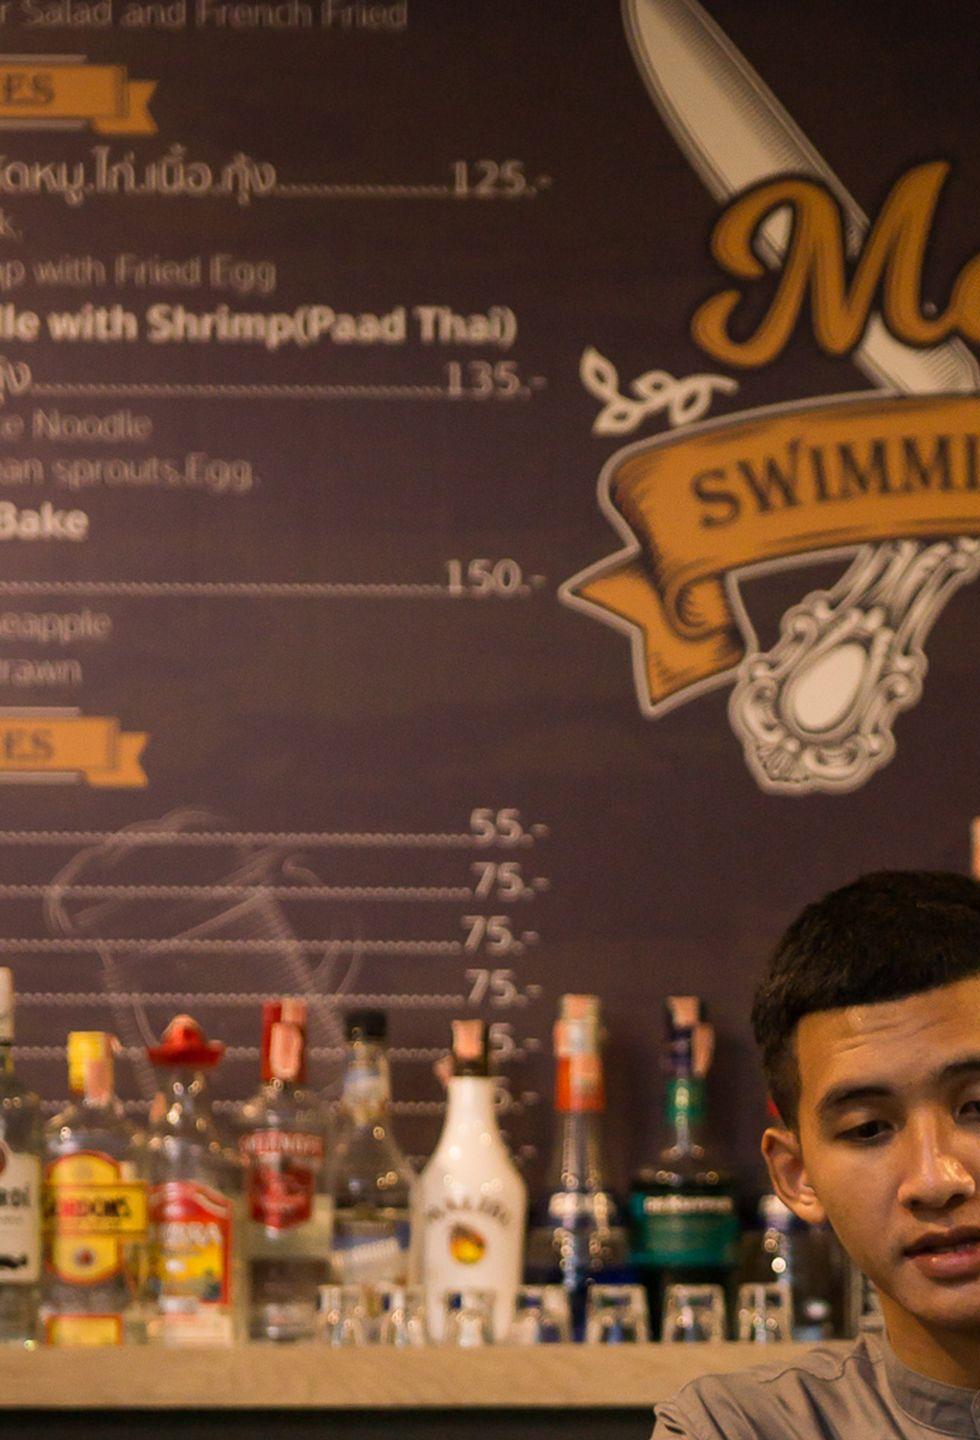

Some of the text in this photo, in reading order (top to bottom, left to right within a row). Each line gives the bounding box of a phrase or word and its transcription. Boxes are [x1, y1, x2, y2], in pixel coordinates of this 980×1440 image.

[33, 255, 108, 286] with
[114, 254, 201, 287] Fried
[209, 254, 278, 295] Egg
[48, 303, 138, 343] with
[32, 408, 155, 441] Noodle
